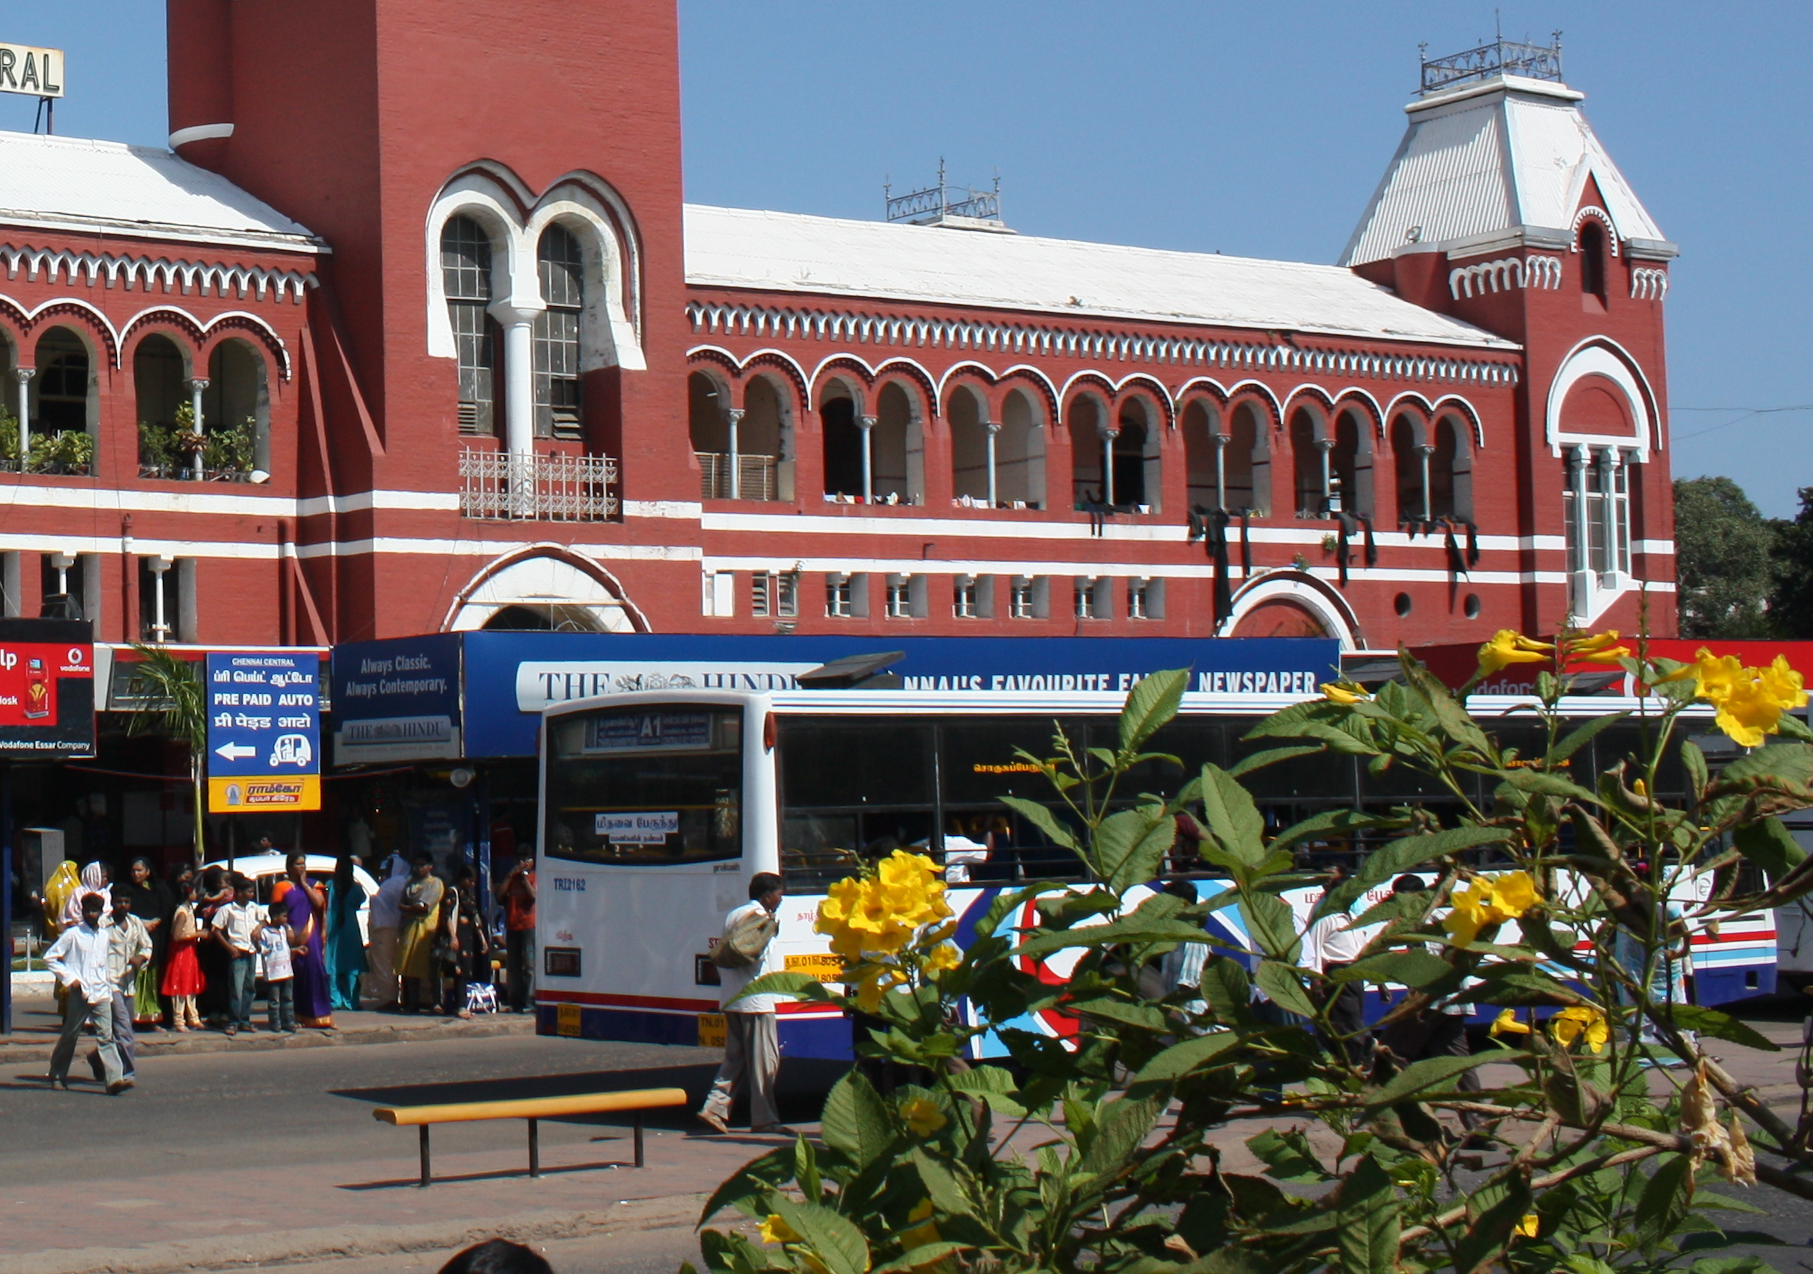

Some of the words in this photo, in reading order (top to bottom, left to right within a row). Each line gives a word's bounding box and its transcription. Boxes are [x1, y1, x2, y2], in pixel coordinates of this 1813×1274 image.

[59, 664, 90, 672] vodafone
[231, 657, 262, 666] CHENNAI
[263, 658, 295, 666] CENTRAL
[361, 658, 393, 676] Always
[395, 654, 431, 671] Classic.
[270, 670, 313, 687] ஆட்டோ
[539, 672, 610, 700] THE
[1199, 671, 1316, 693] NEWSPAPER
[346, 681, 377, 699] Always
[379, 678, 448, 696] Contemporary.
[214, 693, 239, 705] PRE
[242, 693, 272, 705] PAID
[278, 693, 313, 706] AUTO
[214, 712, 232, 727] प्री
[278, 712, 311, 728] आटो
[640, 715, 662, 737] A1
[349, 724, 373, 740] THE
[403, 721, 444, 737] HINDU
[35, 741, 56, 749] Essar
[57, 741, 90, 751] Company
[708, 937, 721, 949] ST
